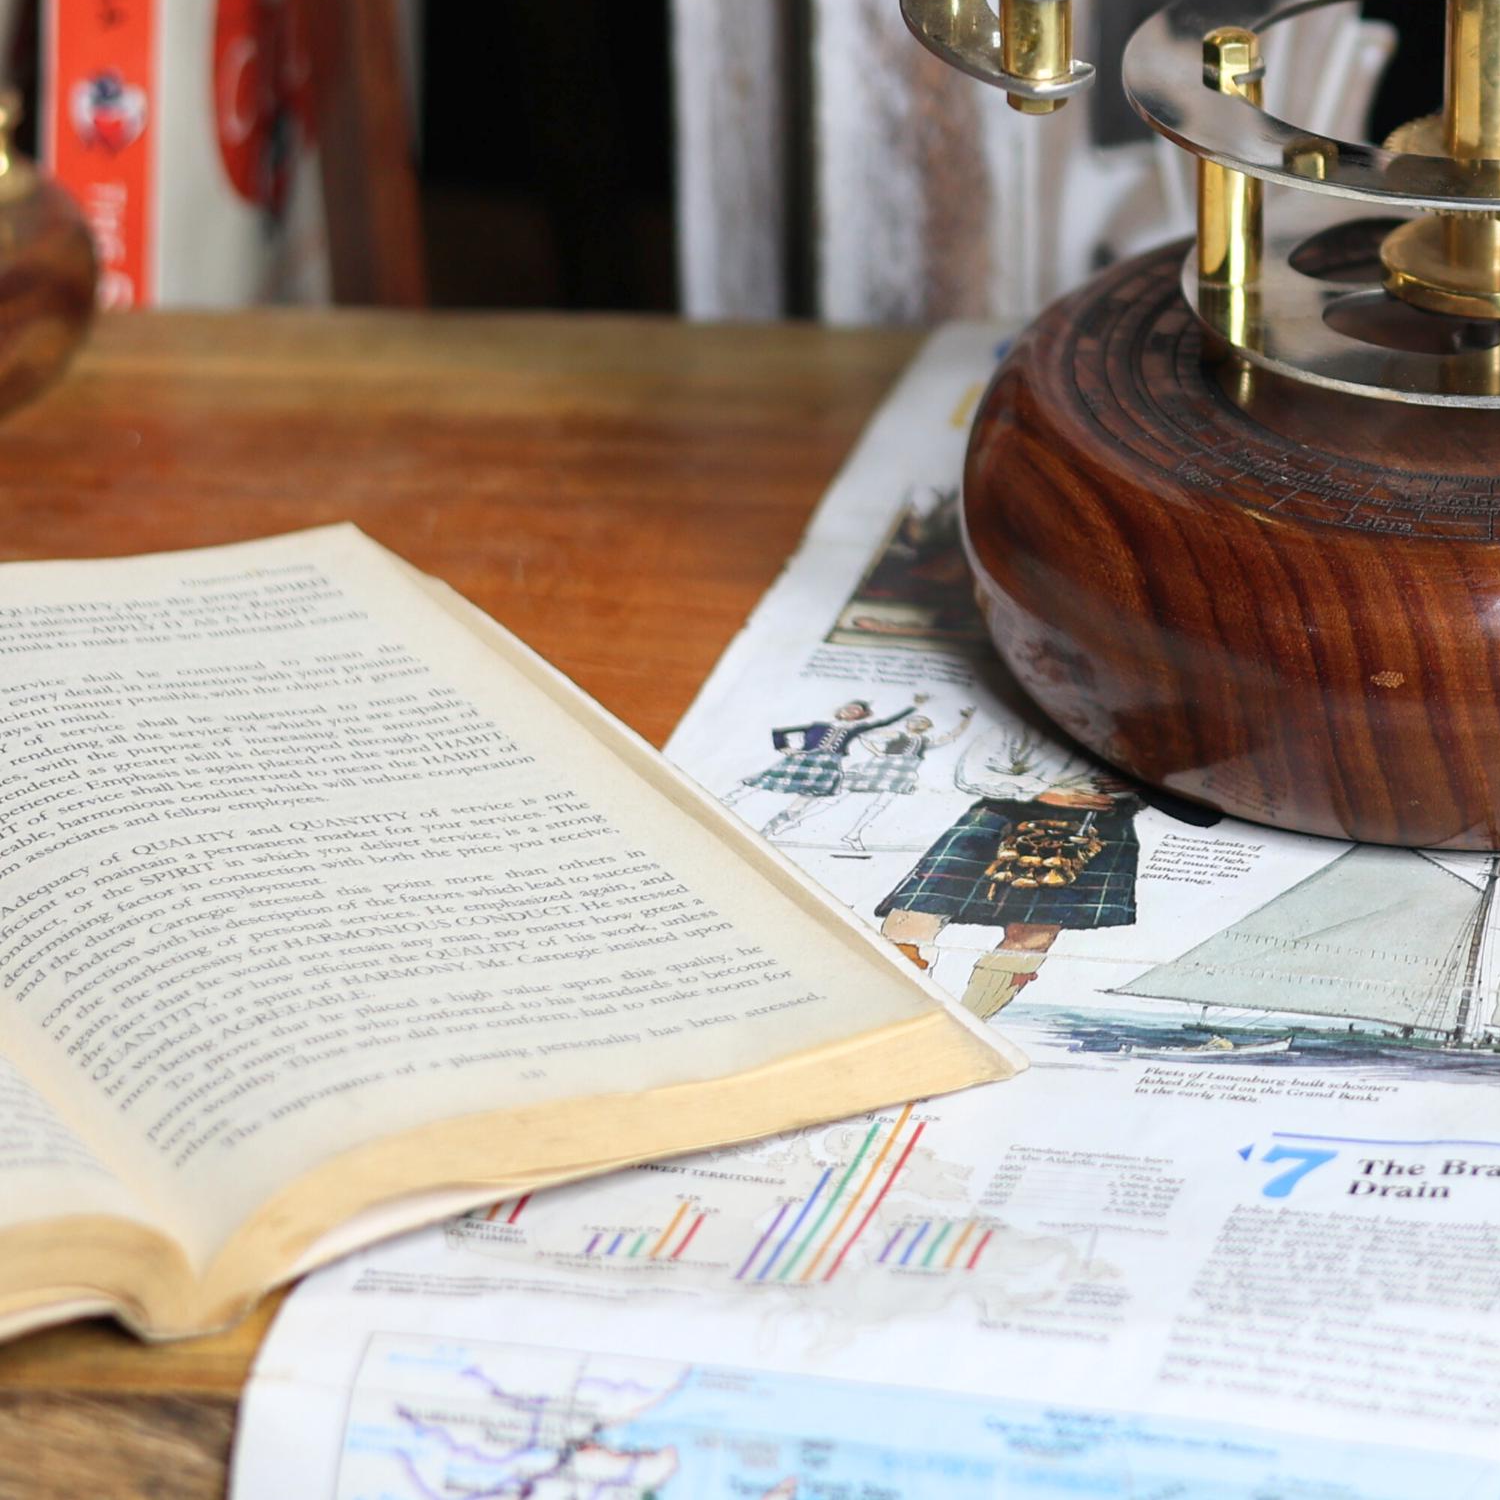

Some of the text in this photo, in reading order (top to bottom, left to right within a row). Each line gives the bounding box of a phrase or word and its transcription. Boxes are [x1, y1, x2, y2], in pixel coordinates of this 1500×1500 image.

[1345, 514, 1413, 533] Libra
[26, 796, 330, 863] associates and fellow employees.
[1160, 841, 1261, 858] Scottish settlers
[1163, 834, 1245, 848] Descendants
[1, 790, 577, 919] Adequacy of QUALITY and QUANTITY of service is not
[1150, 855, 1182, 864] land
[1183, 861, 1222, 869] music
[1153, 849, 1250, 864] perform High-
[1140, 873, 1215, 885] gatherings.
[1146, 864, 1190, 873] dances
[1211, 871, 1238, 879] clan
[1137, 1076, 1181, 1086] fished
[1184, 1079, 1205, 1089] for
[1210, 1082, 1235, 1090] cod
[1260, 1086, 1283, 1095] the
[1286, 1088, 1334, 1099] Grand
[1338, 1093, 1379, 1102] Banks
[1145, 1067, 1186, 1077] Fleets
[1189, 1071, 1204, 1079] of
[1327, 1081, 1399, 1093] schooners
[1152, 1088, 1174, 1096] the
[1177, 1090, 1214, 1100] early
[1261, 1145, 1339, 1198] 7
[1357, 1159, 1425, 1177] The
[1345, 1180, 1452, 1199] Drain
